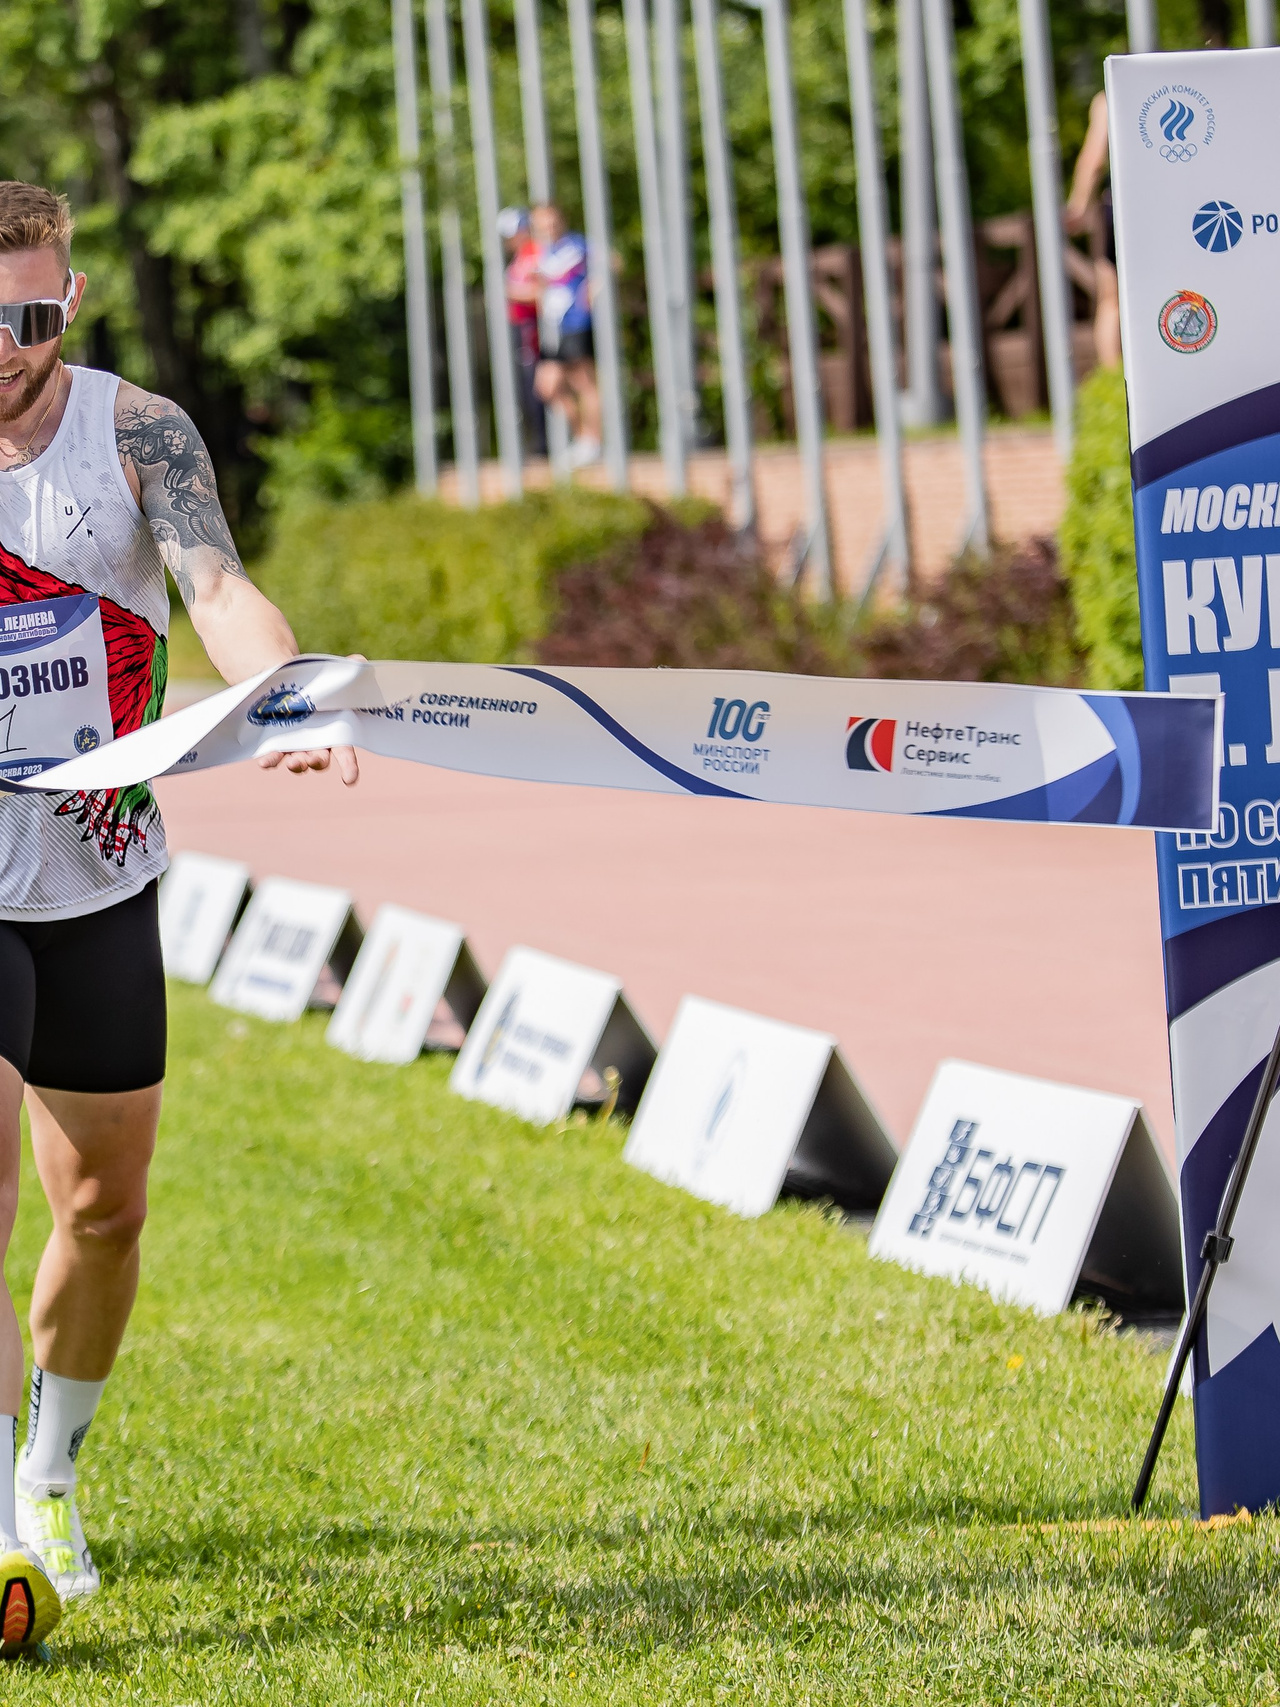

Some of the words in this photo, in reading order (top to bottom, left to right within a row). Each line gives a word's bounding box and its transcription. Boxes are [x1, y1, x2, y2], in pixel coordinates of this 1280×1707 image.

[1138, 84, 1170, 149] ОЛИМПИЙСКИЙ
[1171, 84, 1210, 108] КОМИТЕТ
[1202, 107, 1216, 146] РОССИИ
[1160, 481, 1280, 535] МОСК
[1162, 553, 1280, 656] КУ
[3, 610, 57, 632] ЛЕДНЕВА
[17, 626, 58, 641] пятиборью
[419, 692, 538, 714] СОВРЕМЕННОГО
[412, 708, 470, 728] РОССИИ
[706, 696, 771, 742] 100
[905, 720, 1022, 748] НефтеТранс
[692, 742, 772, 762] МИНСПОРТ
[903, 743, 972, 767] Сервис
[22, 763, 43, 777] 2023
[702, 757, 761, 775] РОССИИ
